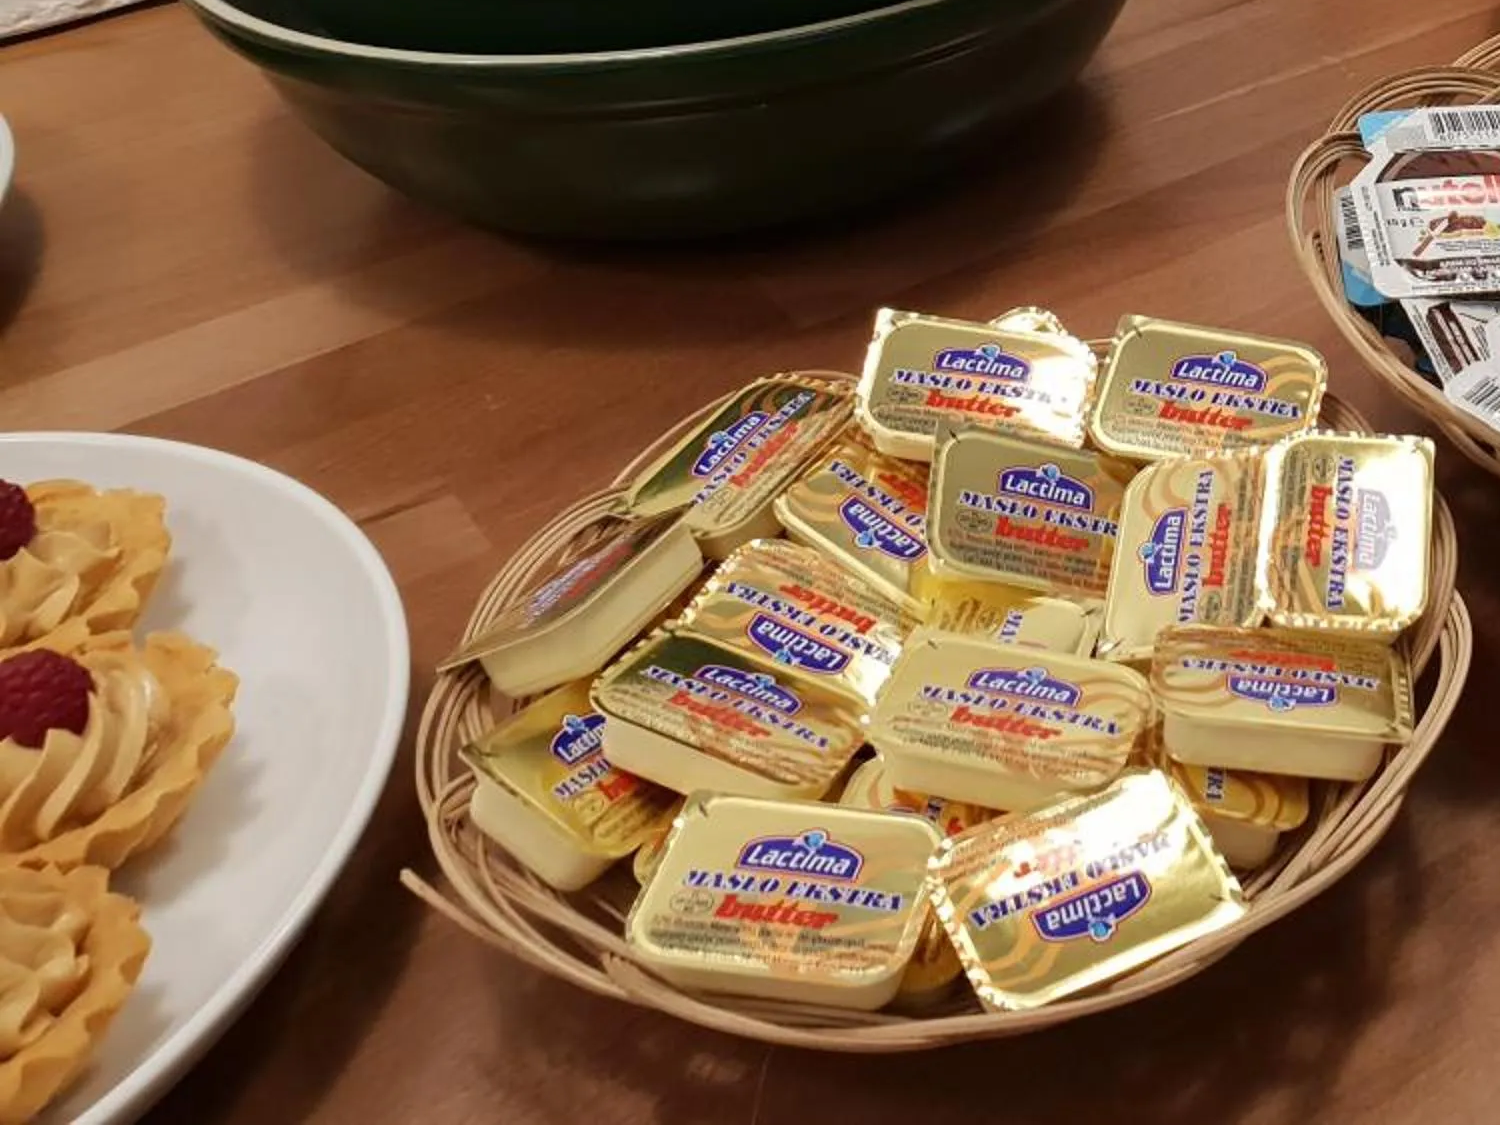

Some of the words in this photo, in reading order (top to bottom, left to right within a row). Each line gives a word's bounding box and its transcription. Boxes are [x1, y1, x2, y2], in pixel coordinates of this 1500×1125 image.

[941, 353, 1024, 379] Lactima
[1178, 362, 1258, 389] Lactima
[926, 389, 1022, 418] butter
[1157, 400, 1254, 431] butter
[1211, 392, 1302, 419] EKSTRA
[698, 415, 762, 475] Lactima
[1005, 475, 1086, 506] Lactima
[849, 503, 921, 555] Lactima
[995, 516, 1090, 551] butter
[1045, 509, 1118, 537] EKSTR
[1306, 485, 1333, 567] butter
[1154, 516, 1181, 588] Lactima
[1201, 504, 1231, 587] butter
[756, 619, 843, 668] Lactima
[705, 667, 793, 712] Lactima
[976, 673, 1071, 703] Lactima
[1236, 679, 1330, 702] Lactima
[950, 706, 1062, 739] butter
[1015, 702, 1120, 736] EKSTRA
[747, 844, 852, 875] Lactima
[715, 894, 839, 930] butter
[786, 880, 904, 912] EKSTRA
[970, 871, 1080, 929] EKSTRA
[1045, 875, 1141, 930] Lactima
